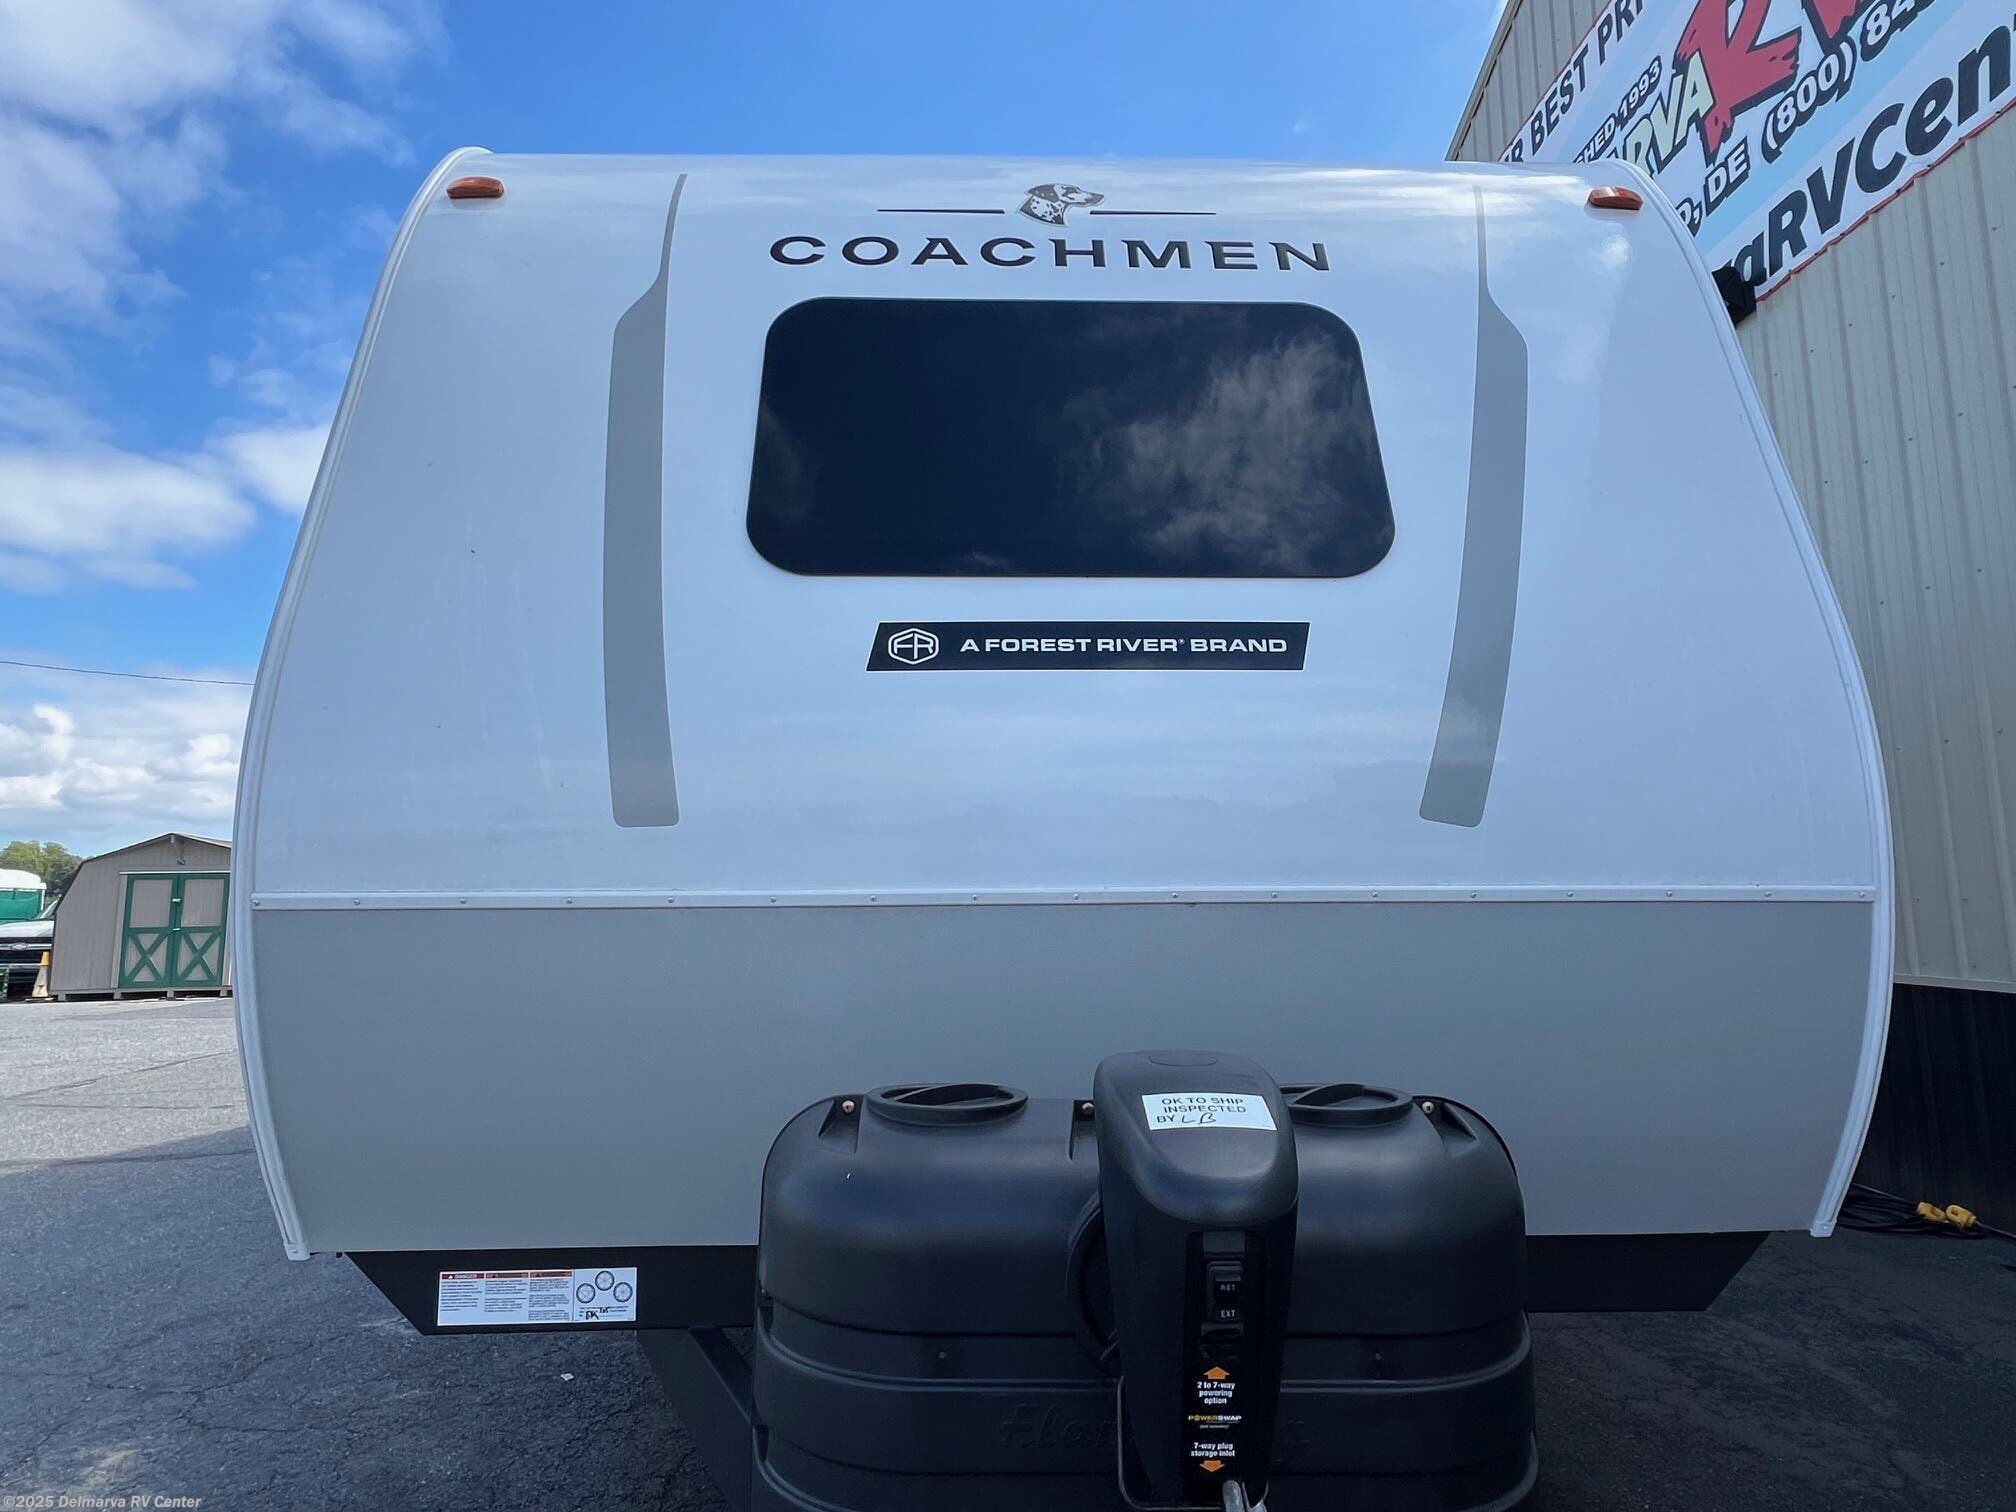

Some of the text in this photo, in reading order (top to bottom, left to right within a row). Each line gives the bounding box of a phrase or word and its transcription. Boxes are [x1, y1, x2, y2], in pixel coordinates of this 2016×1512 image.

[1619, 55, 1662, 122] 1993
[1530, 43, 1589, 156] BEST
[1607, 50, 1715, 178] RVA
[1704, 140, 1745, 205] DE
[1765, 41, 1852, 150] (800)
[1719, 13, 2016, 287] aRVCen
[769, 236, 1331, 271] COACHMEN
[960, 638, 979, 652] A
[986, 638, 1091, 652] FOREST
[1191, 638, 1287, 653] BRAND
[1162, 1097, 1181, 1105] OK
[1210, 1097, 1243, 1105] SHIP
[1164, 1105, 1246, 1113] INSPECTED
[1157, 1115, 1176, 1123] BY
[1220, 1309, 1235, 1318] EXT
[1213, 1382, 1235, 1390] 7-way
[1199, 1390, 1232, 1398] powering
[1204, 1397, 1227, 1405] option
[1193, 1442, 1233, 1450] 7-way plug
